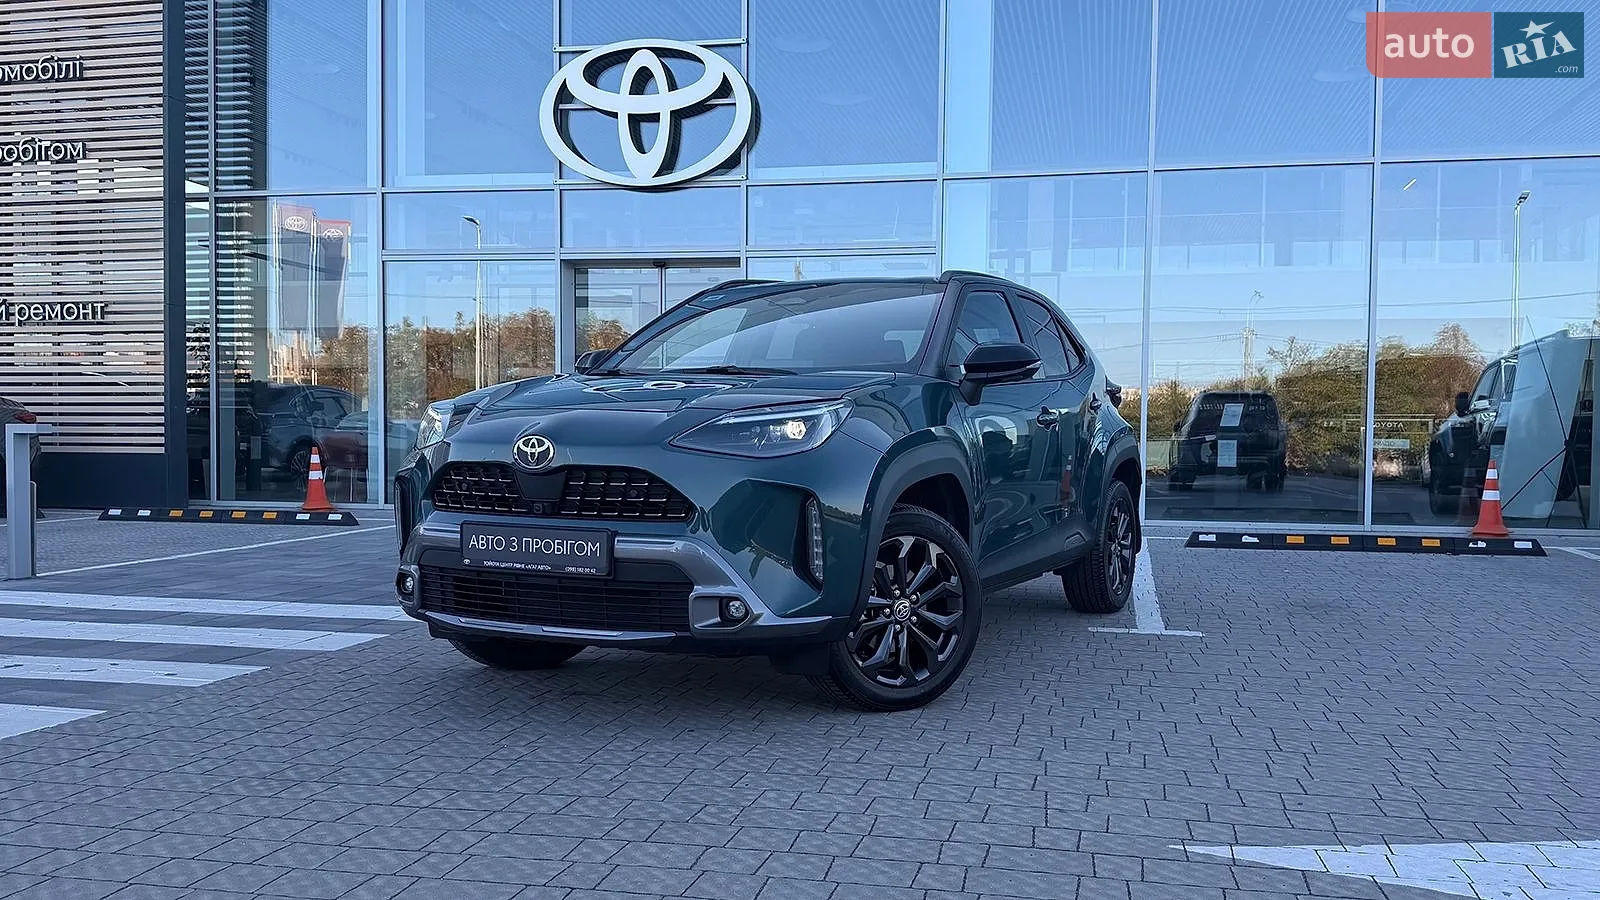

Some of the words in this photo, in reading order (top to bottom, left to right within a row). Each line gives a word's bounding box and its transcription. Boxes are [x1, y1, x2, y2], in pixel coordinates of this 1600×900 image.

[0, 54, 80, 81] мобілі
[0, 136, 83, 161] обігом
[15, 303, 105, 326] ремонт
[468, 534, 506, 551] АВТО
[522, 537, 600, 557] ПРОБІГОМ
